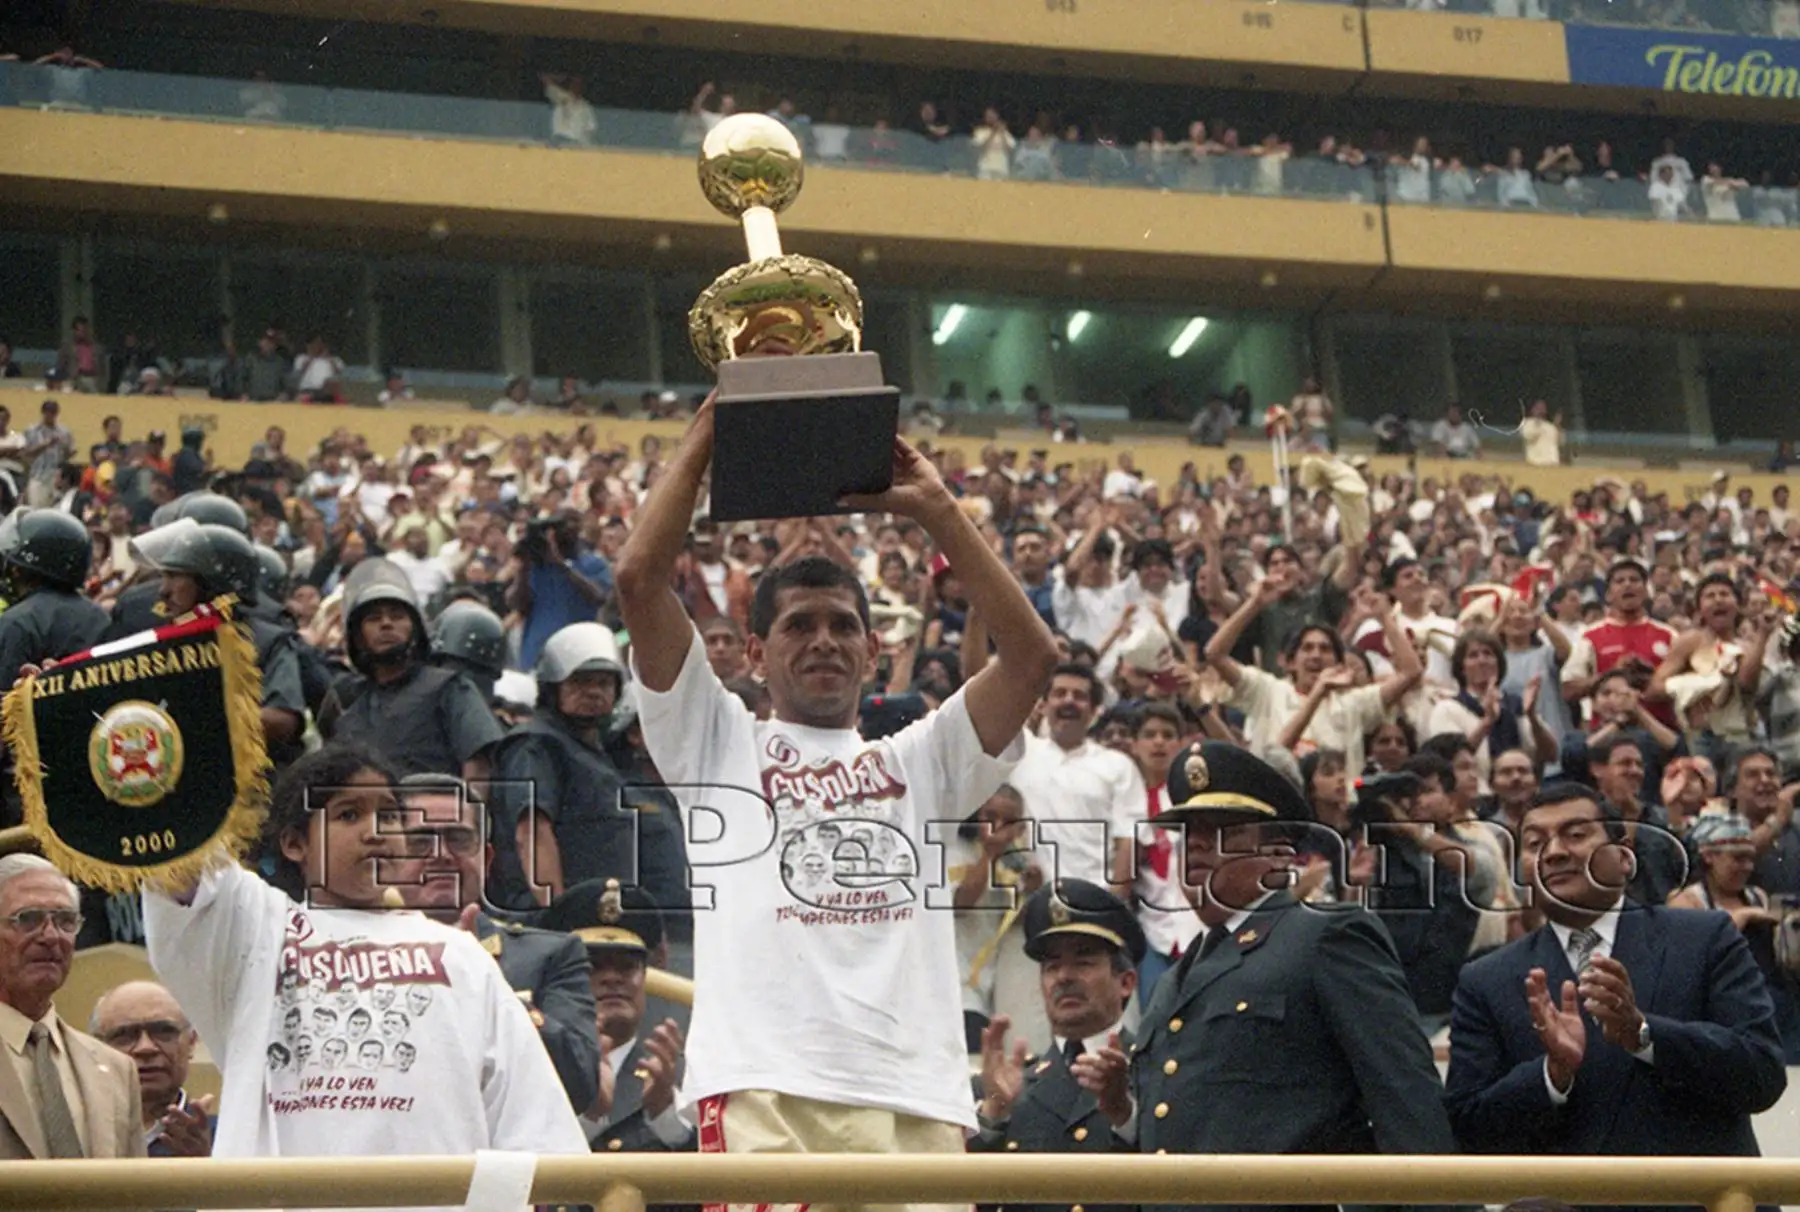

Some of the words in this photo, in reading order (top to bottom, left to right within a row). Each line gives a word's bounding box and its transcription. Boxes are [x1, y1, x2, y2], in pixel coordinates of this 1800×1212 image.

[120, 829, 176, 856] 2000
[326, 1076, 346, 1091] LO
[349, 1076, 379, 1091] VEN
[340, 1095, 377, 1111] ESTA
[380, 1096, 415, 1113] VEZ!
